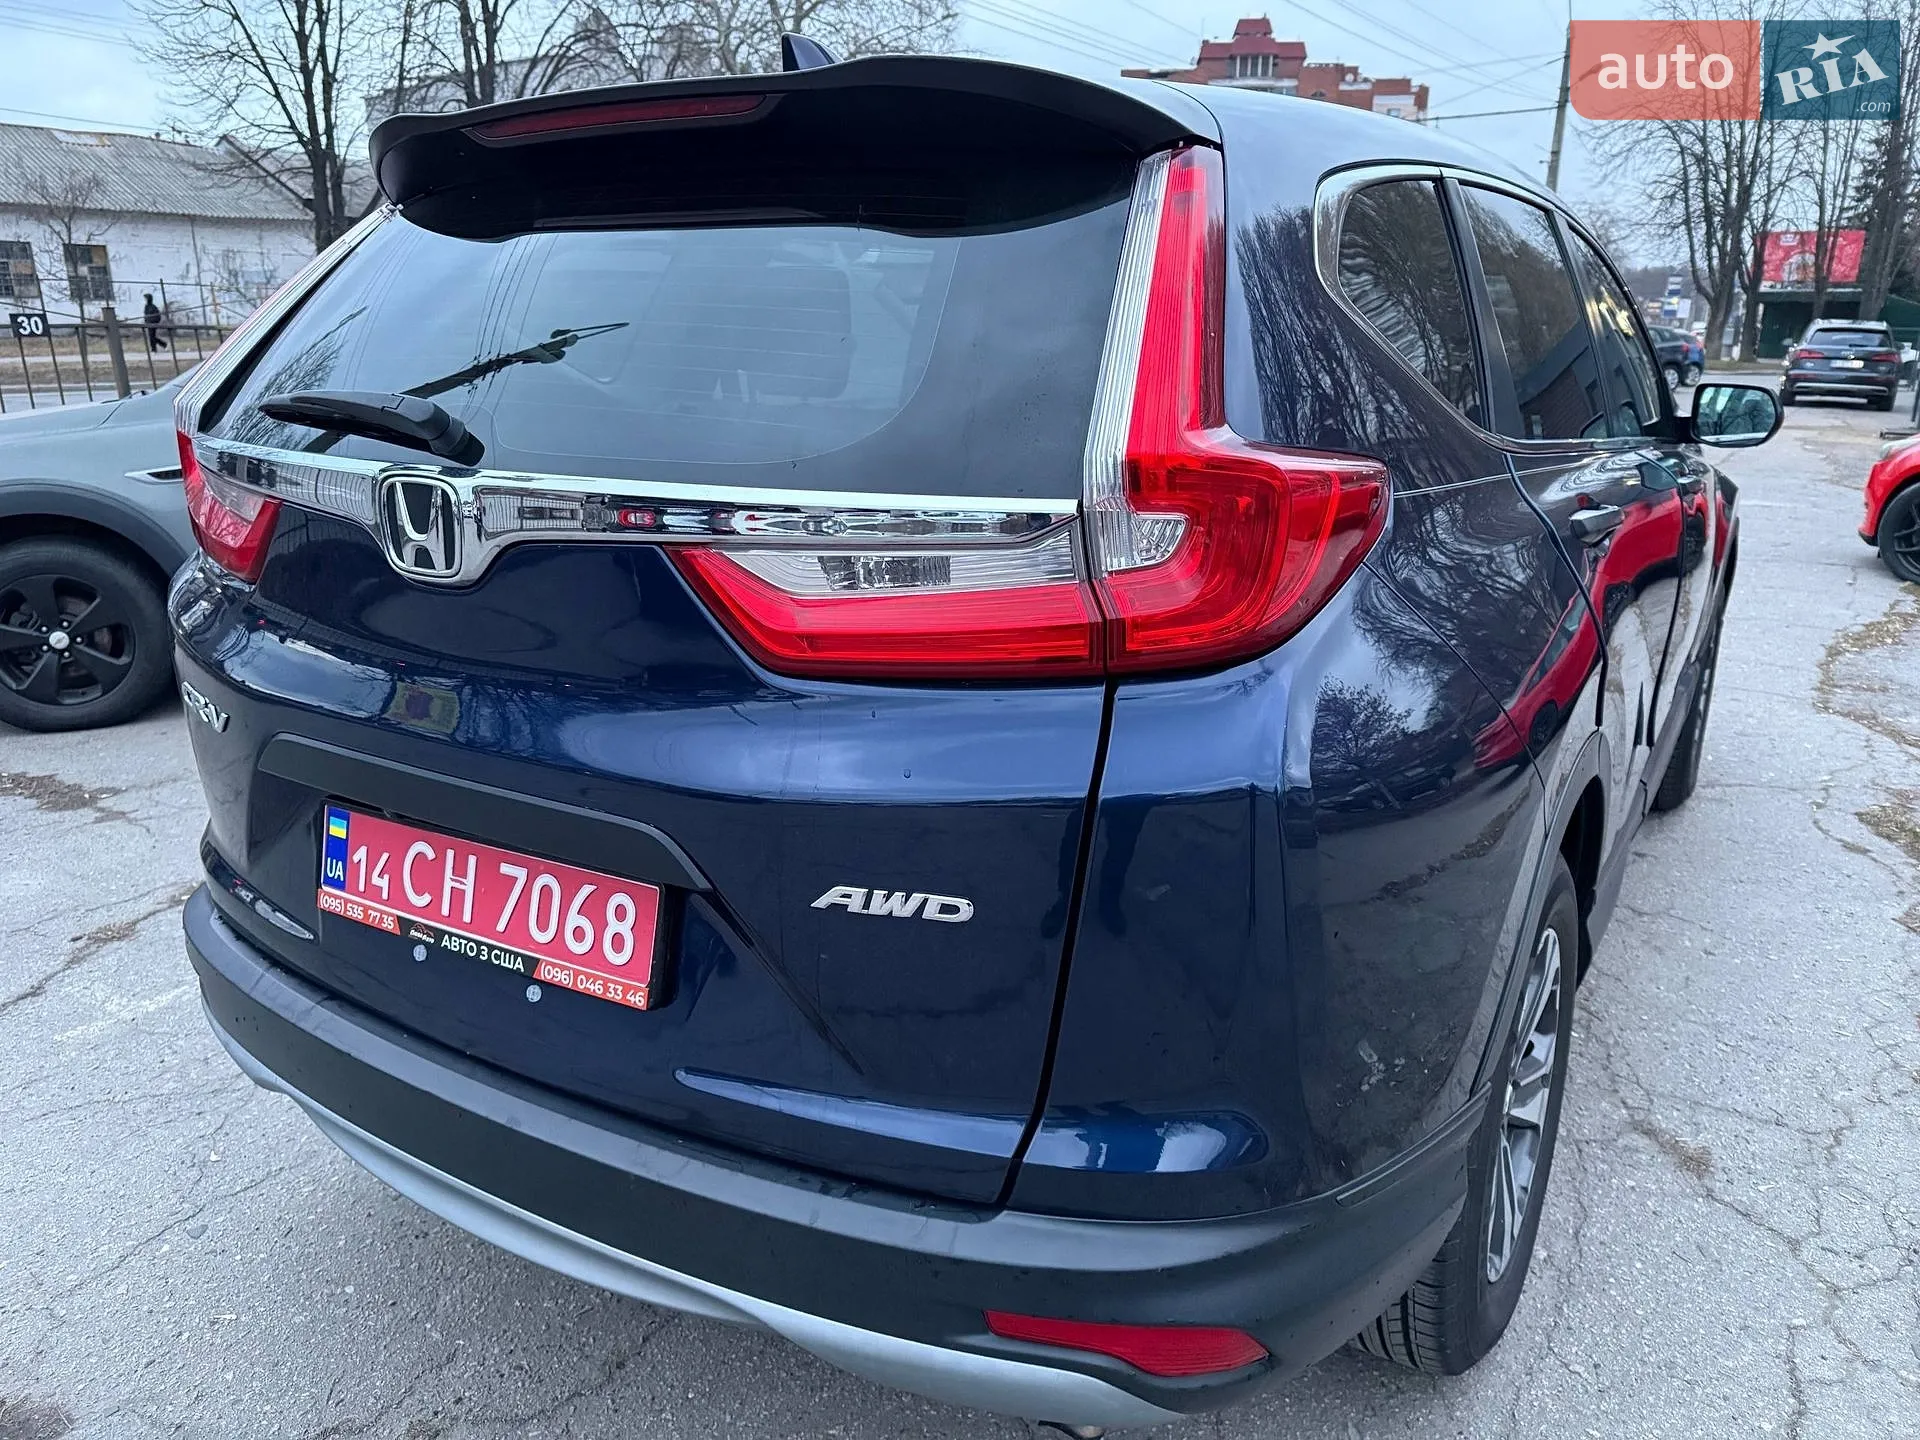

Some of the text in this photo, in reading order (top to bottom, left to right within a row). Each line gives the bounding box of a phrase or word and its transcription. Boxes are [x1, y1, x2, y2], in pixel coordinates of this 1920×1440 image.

[17, 316, 43, 335] 30
[326, 857, 344, 881] UA
[320, 893, 345, 915] (095)
[346, 902, 364, 920] 535
[352, 841, 636, 966] 14 CH 7068
[810, 885, 975, 923] AWD
[441, 934, 477, 957] АВТО
[491, 949, 524, 973] США
[540, 961, 645, 1006] (096) 046 33 46
